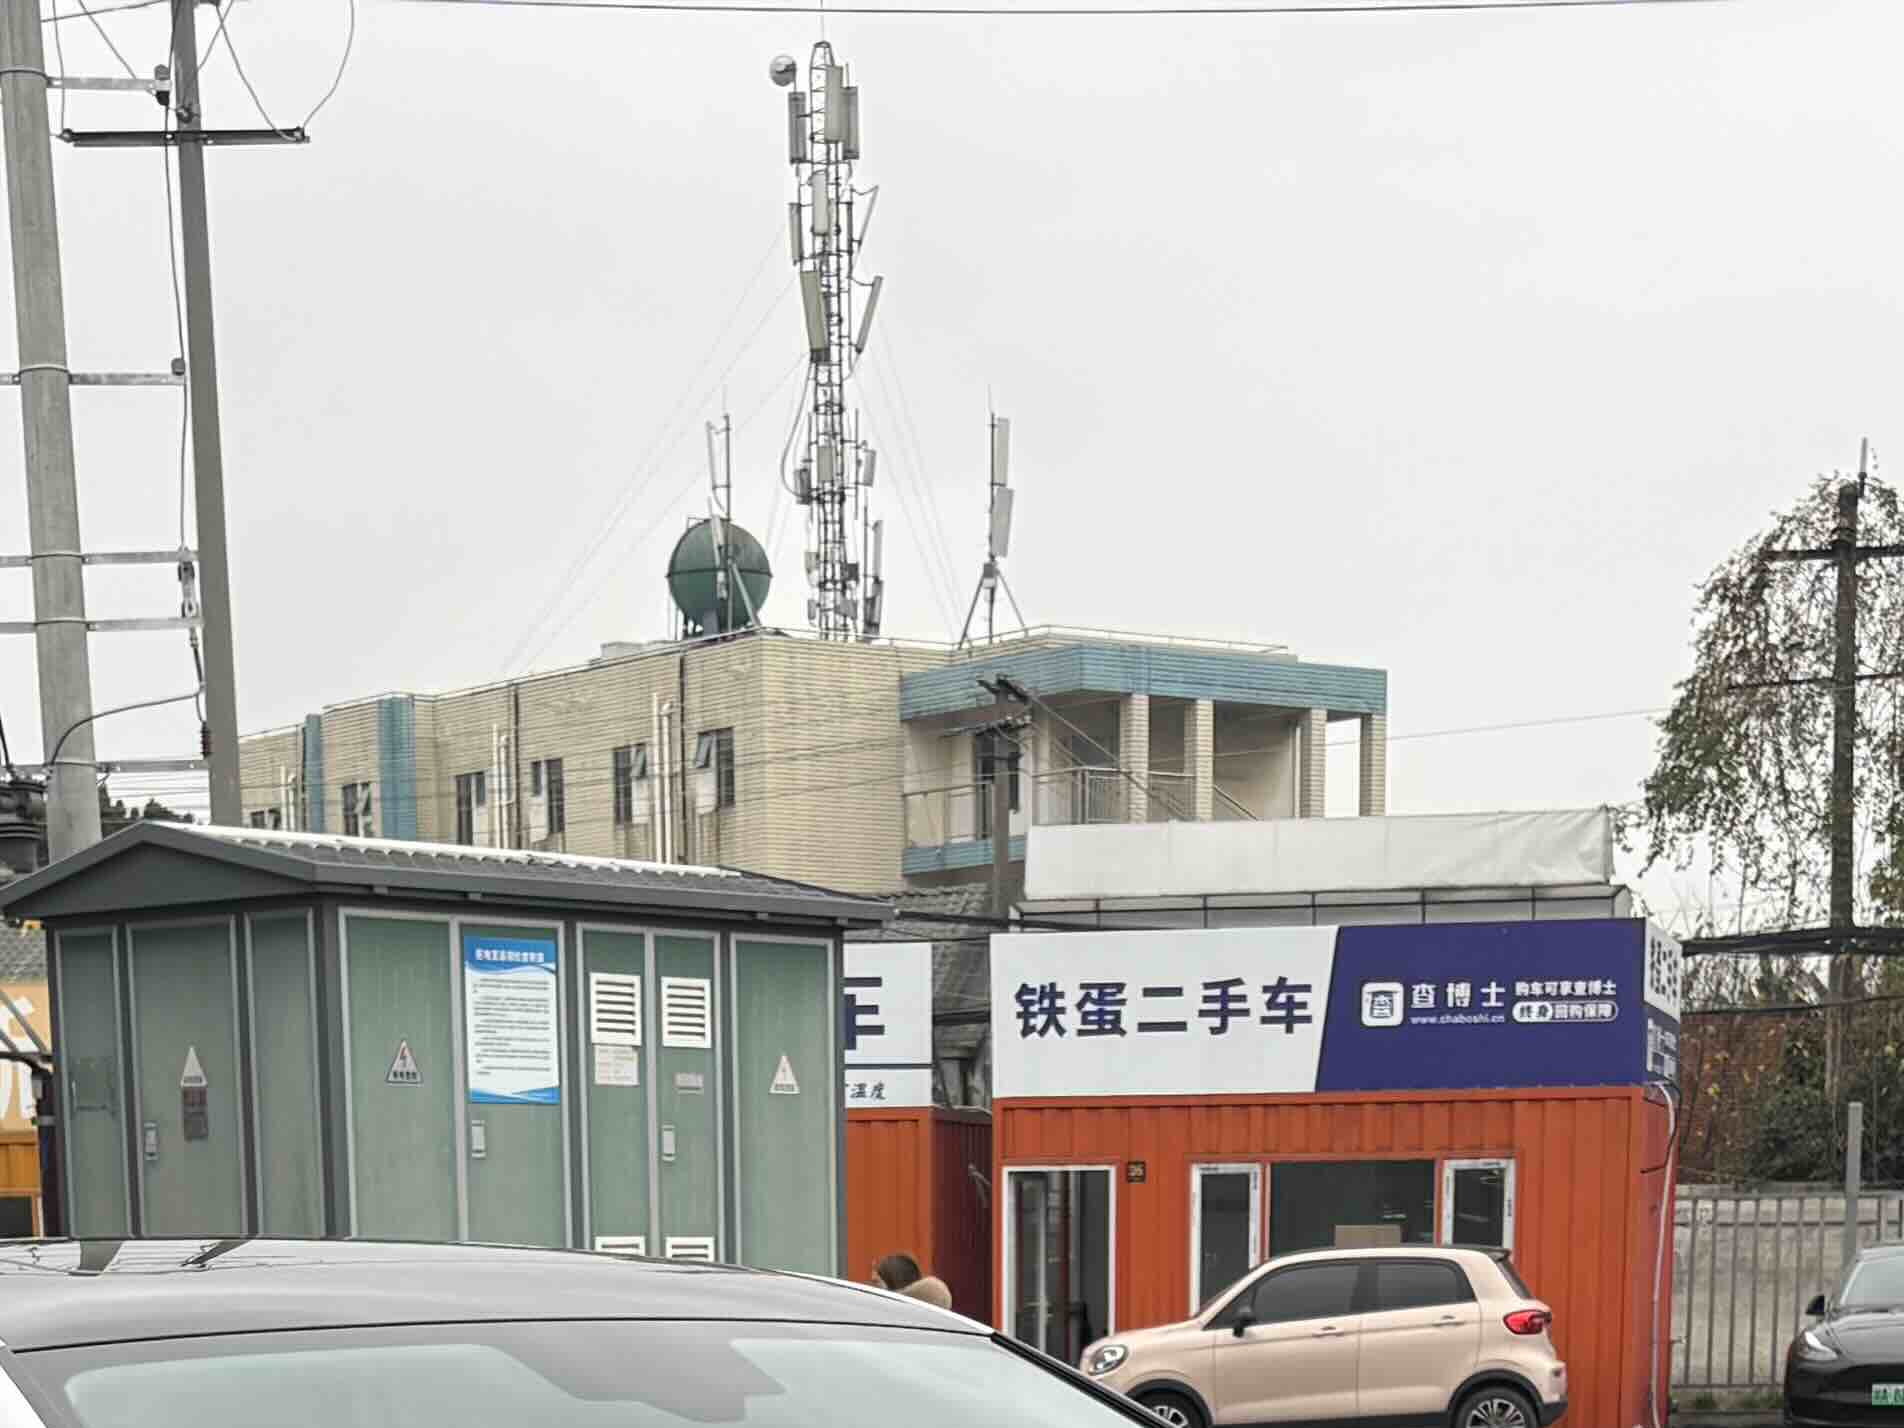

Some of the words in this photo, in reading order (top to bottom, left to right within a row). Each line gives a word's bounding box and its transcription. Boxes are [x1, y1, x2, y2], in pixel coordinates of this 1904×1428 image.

[1014, 976, 1313, 1038] 铁蛋二手车
[1410, 982, 1506, 1009] 查博士
[844, 1080, 887, 1101] 温度
